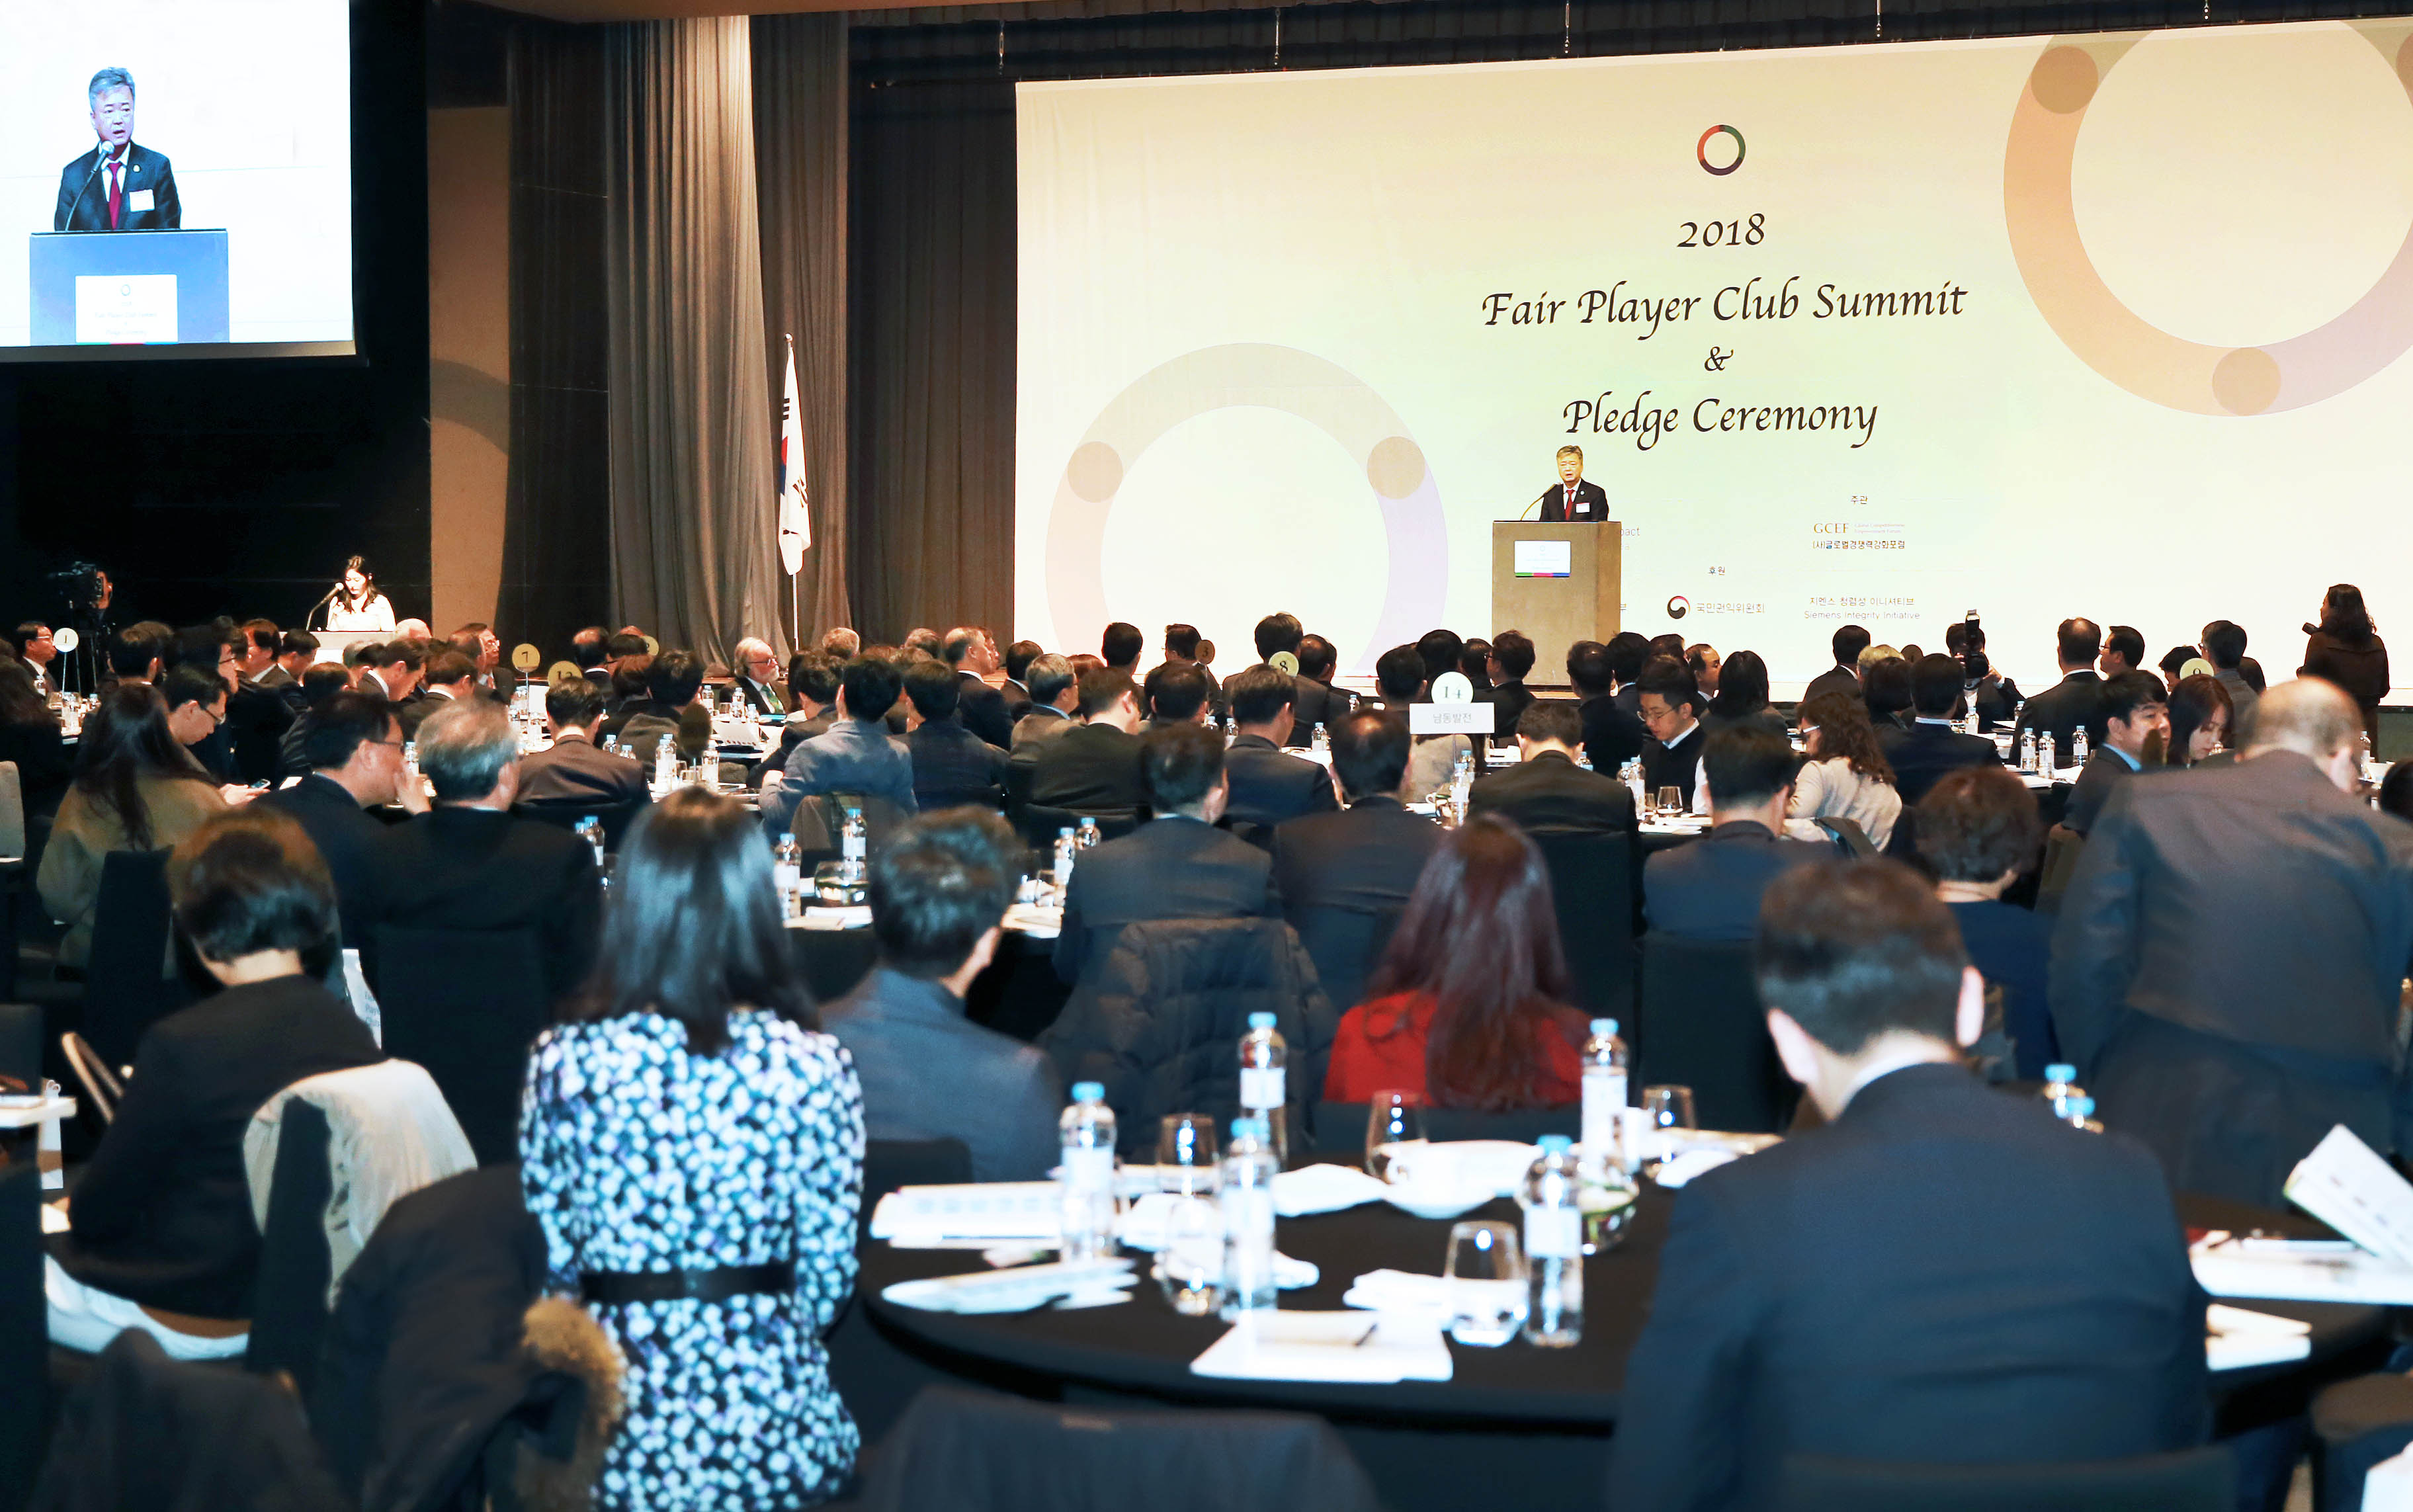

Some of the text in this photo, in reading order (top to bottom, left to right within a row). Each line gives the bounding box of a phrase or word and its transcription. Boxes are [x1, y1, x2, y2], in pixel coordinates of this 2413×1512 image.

[1676, 212, 1765, 248] 2018
[1482, 275, 1969, 341] Fair Player Club Summit
[1704, 346, 1734, 372] &
[1562, 390, 1878, 451] Pledge Ceremony
[1849, 495, 1869, 505] 주관
[1813, 523, 1849, 534] GCEF
[1708, 566, 1726, 576] 후원
[1810, 597, 1836, 607] 지멘스
[1870, 597, 1915, 606] 이니셔티브
[1696, 603, 1765, 614] 국민권익위원회
[1804, 610, 1920, 620] Siemens Integrity Initiative
[521, 651, 529, 663] 7
[1279, 659, 1289, 673] 8
[1443, 685, 1462, 700] 14
[1433, 712, 1472, 724] 남동발전
